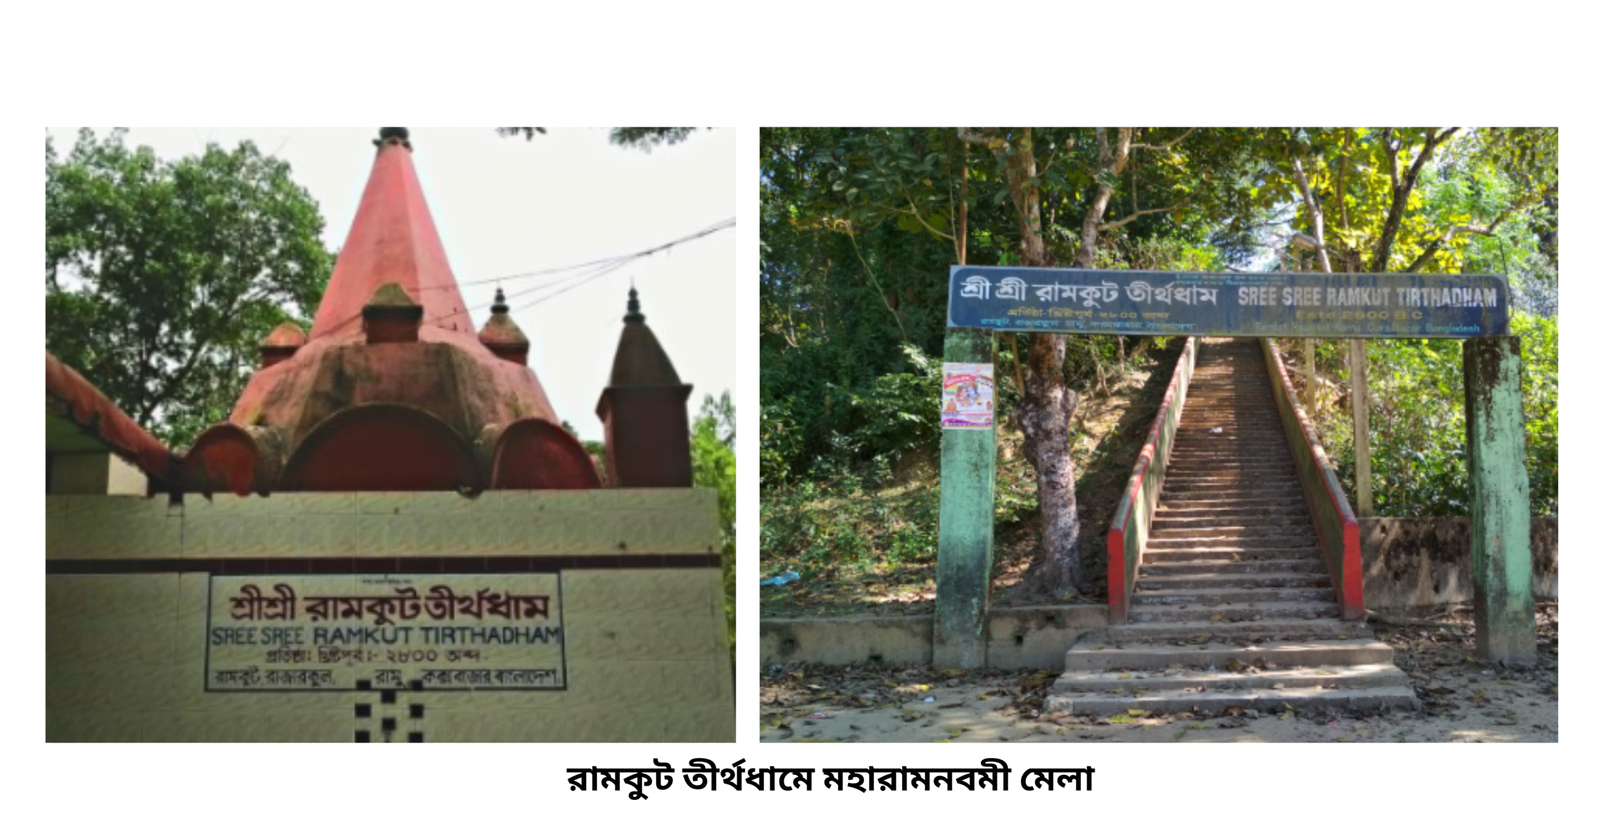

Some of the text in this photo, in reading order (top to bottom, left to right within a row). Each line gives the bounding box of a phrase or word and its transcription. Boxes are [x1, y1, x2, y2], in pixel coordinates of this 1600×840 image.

[960, 275, 1219, 308] শ্রী শ্রী রামকুট তীর্থধাম
[1238, 286, 1497, 307] SREE SREE RAMKUT TIRTHADHAM
[1426, 323, 1480, 334] Bangladesh
[303, 588, 421, 625] রামকুট
[423, 585, 550, 621] তীর্থধাম
[212, 627, 561, 646] SREE SREE RAMKUT TIRTHADHAM
[386, 649, 438, 664] ২৮০০
